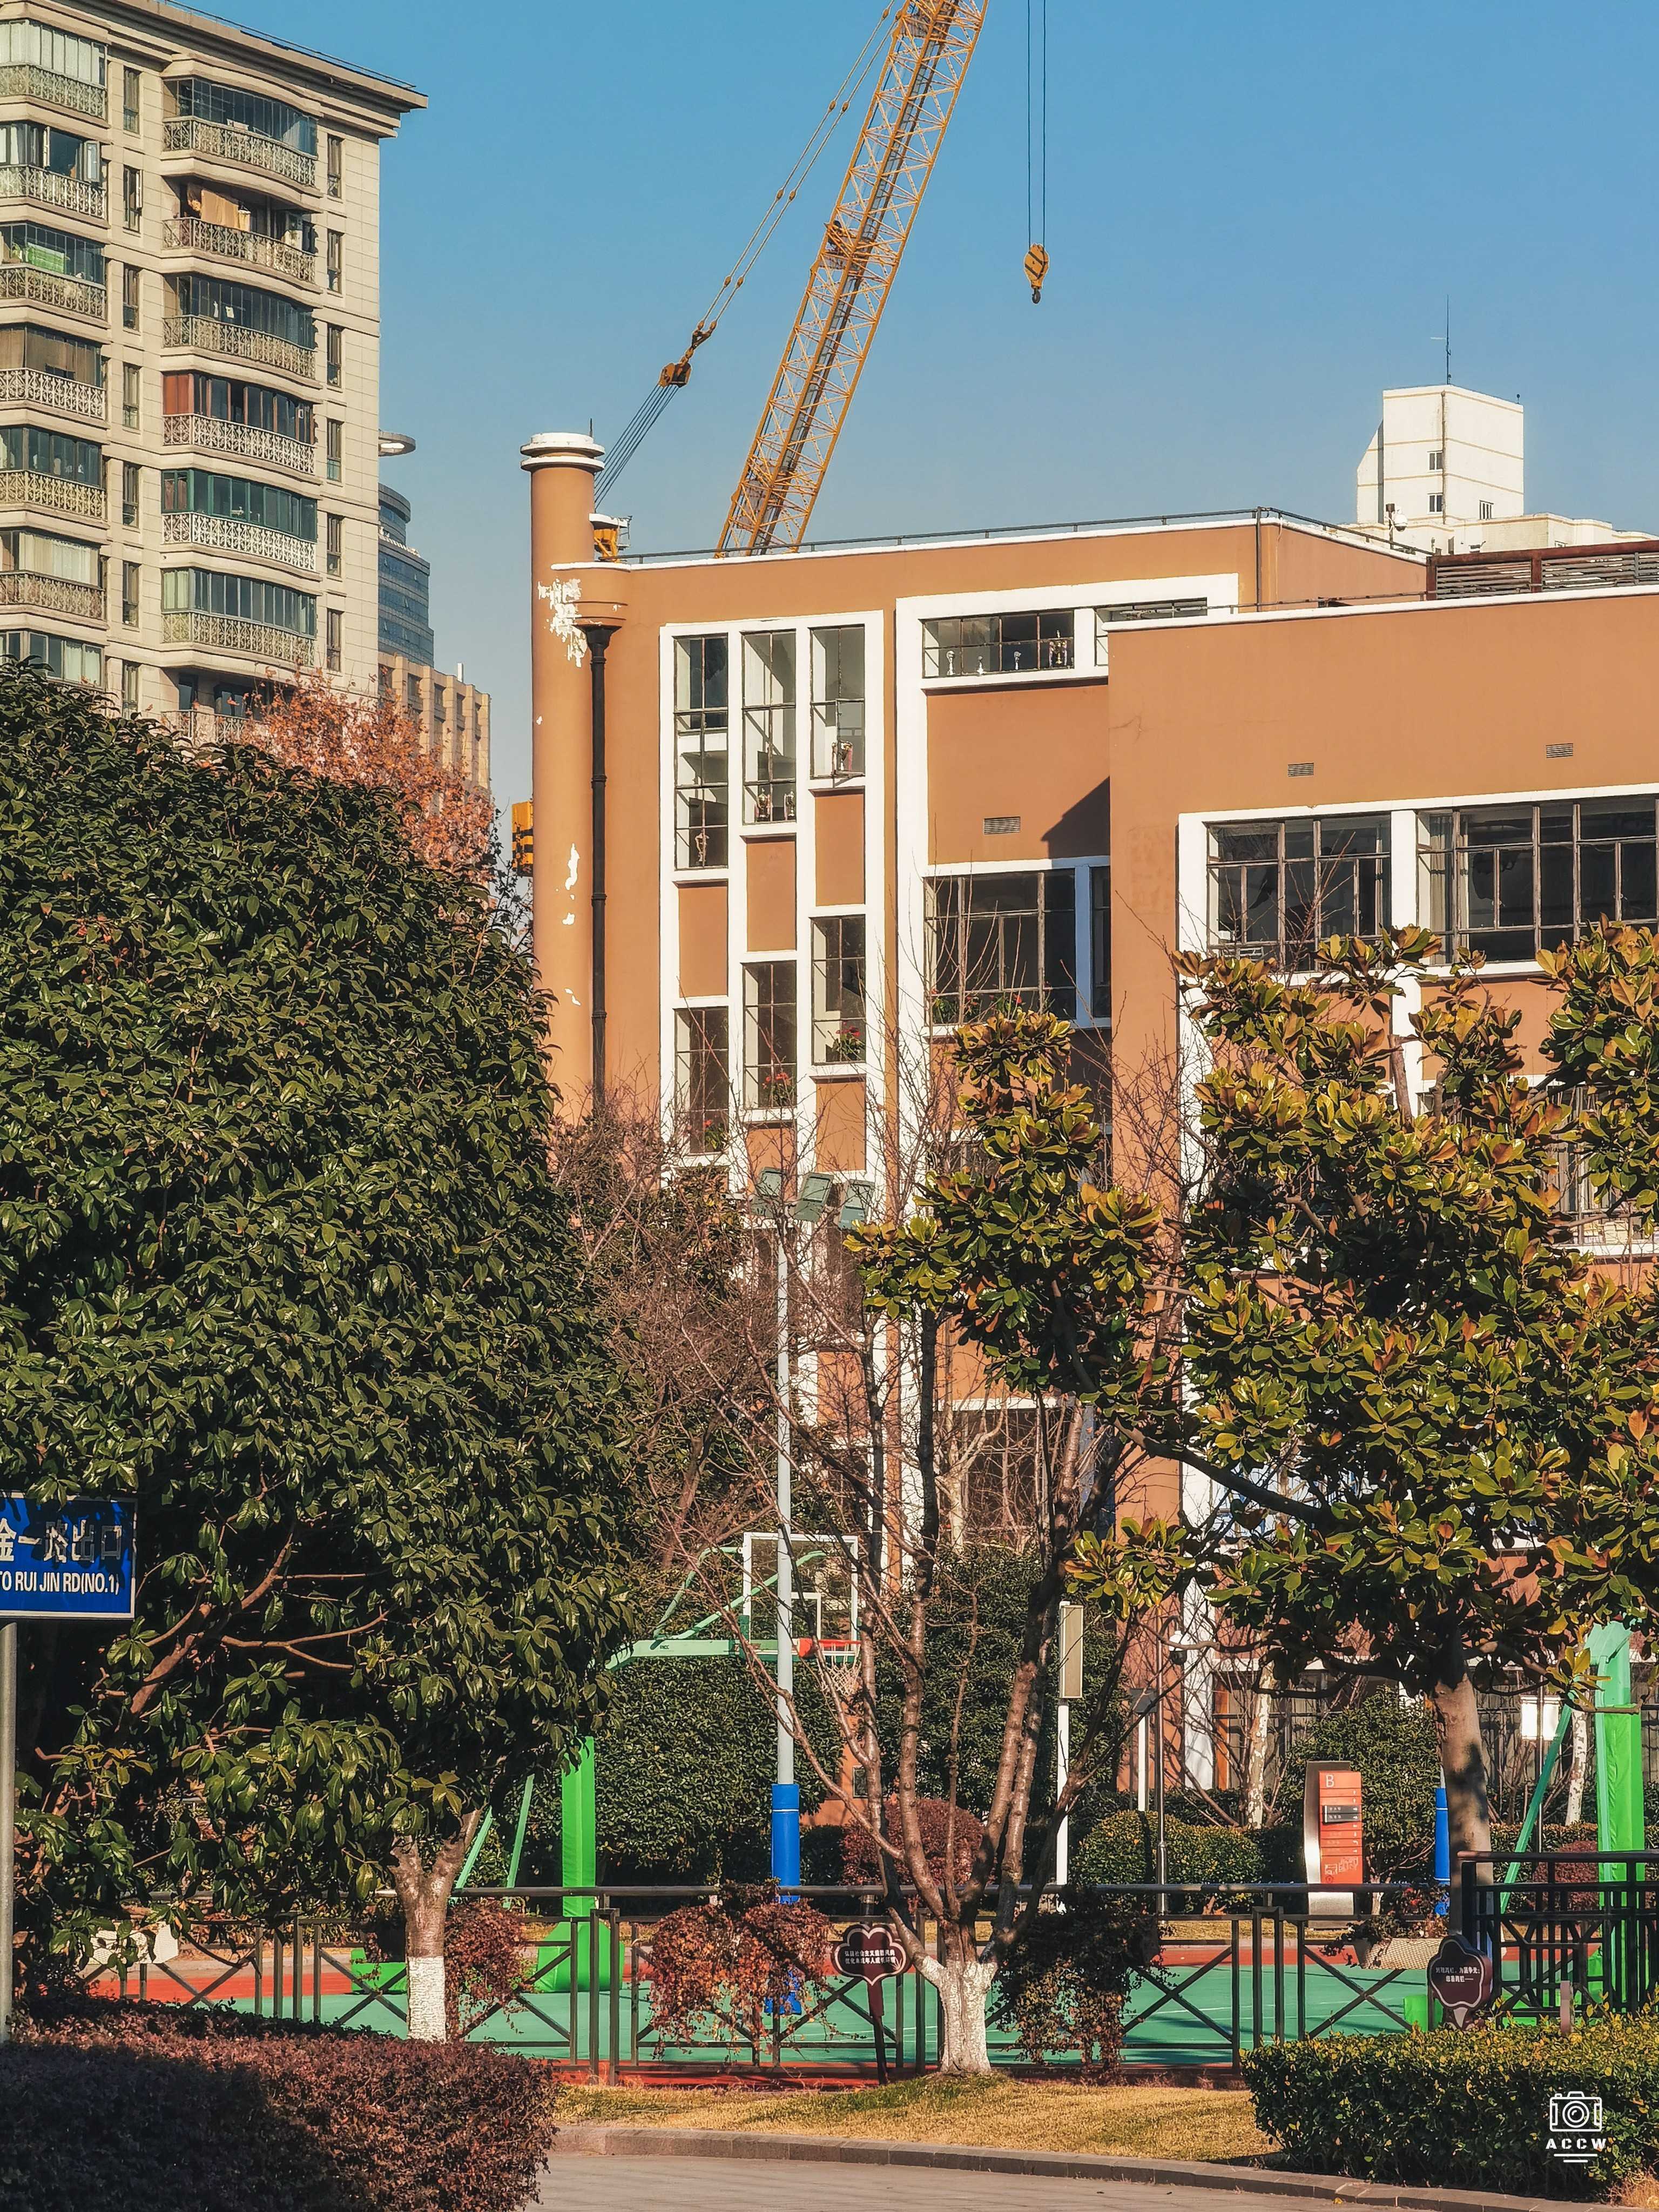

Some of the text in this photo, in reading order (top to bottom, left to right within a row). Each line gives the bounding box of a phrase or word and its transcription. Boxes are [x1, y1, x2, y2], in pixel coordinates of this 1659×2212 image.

[0, 1570, 12, 1591] O
[15, 1572, 37, 1592] RUI
[39, 1572, 60, 1592] JIN
[1326, 1775, 1335, 1788] B
